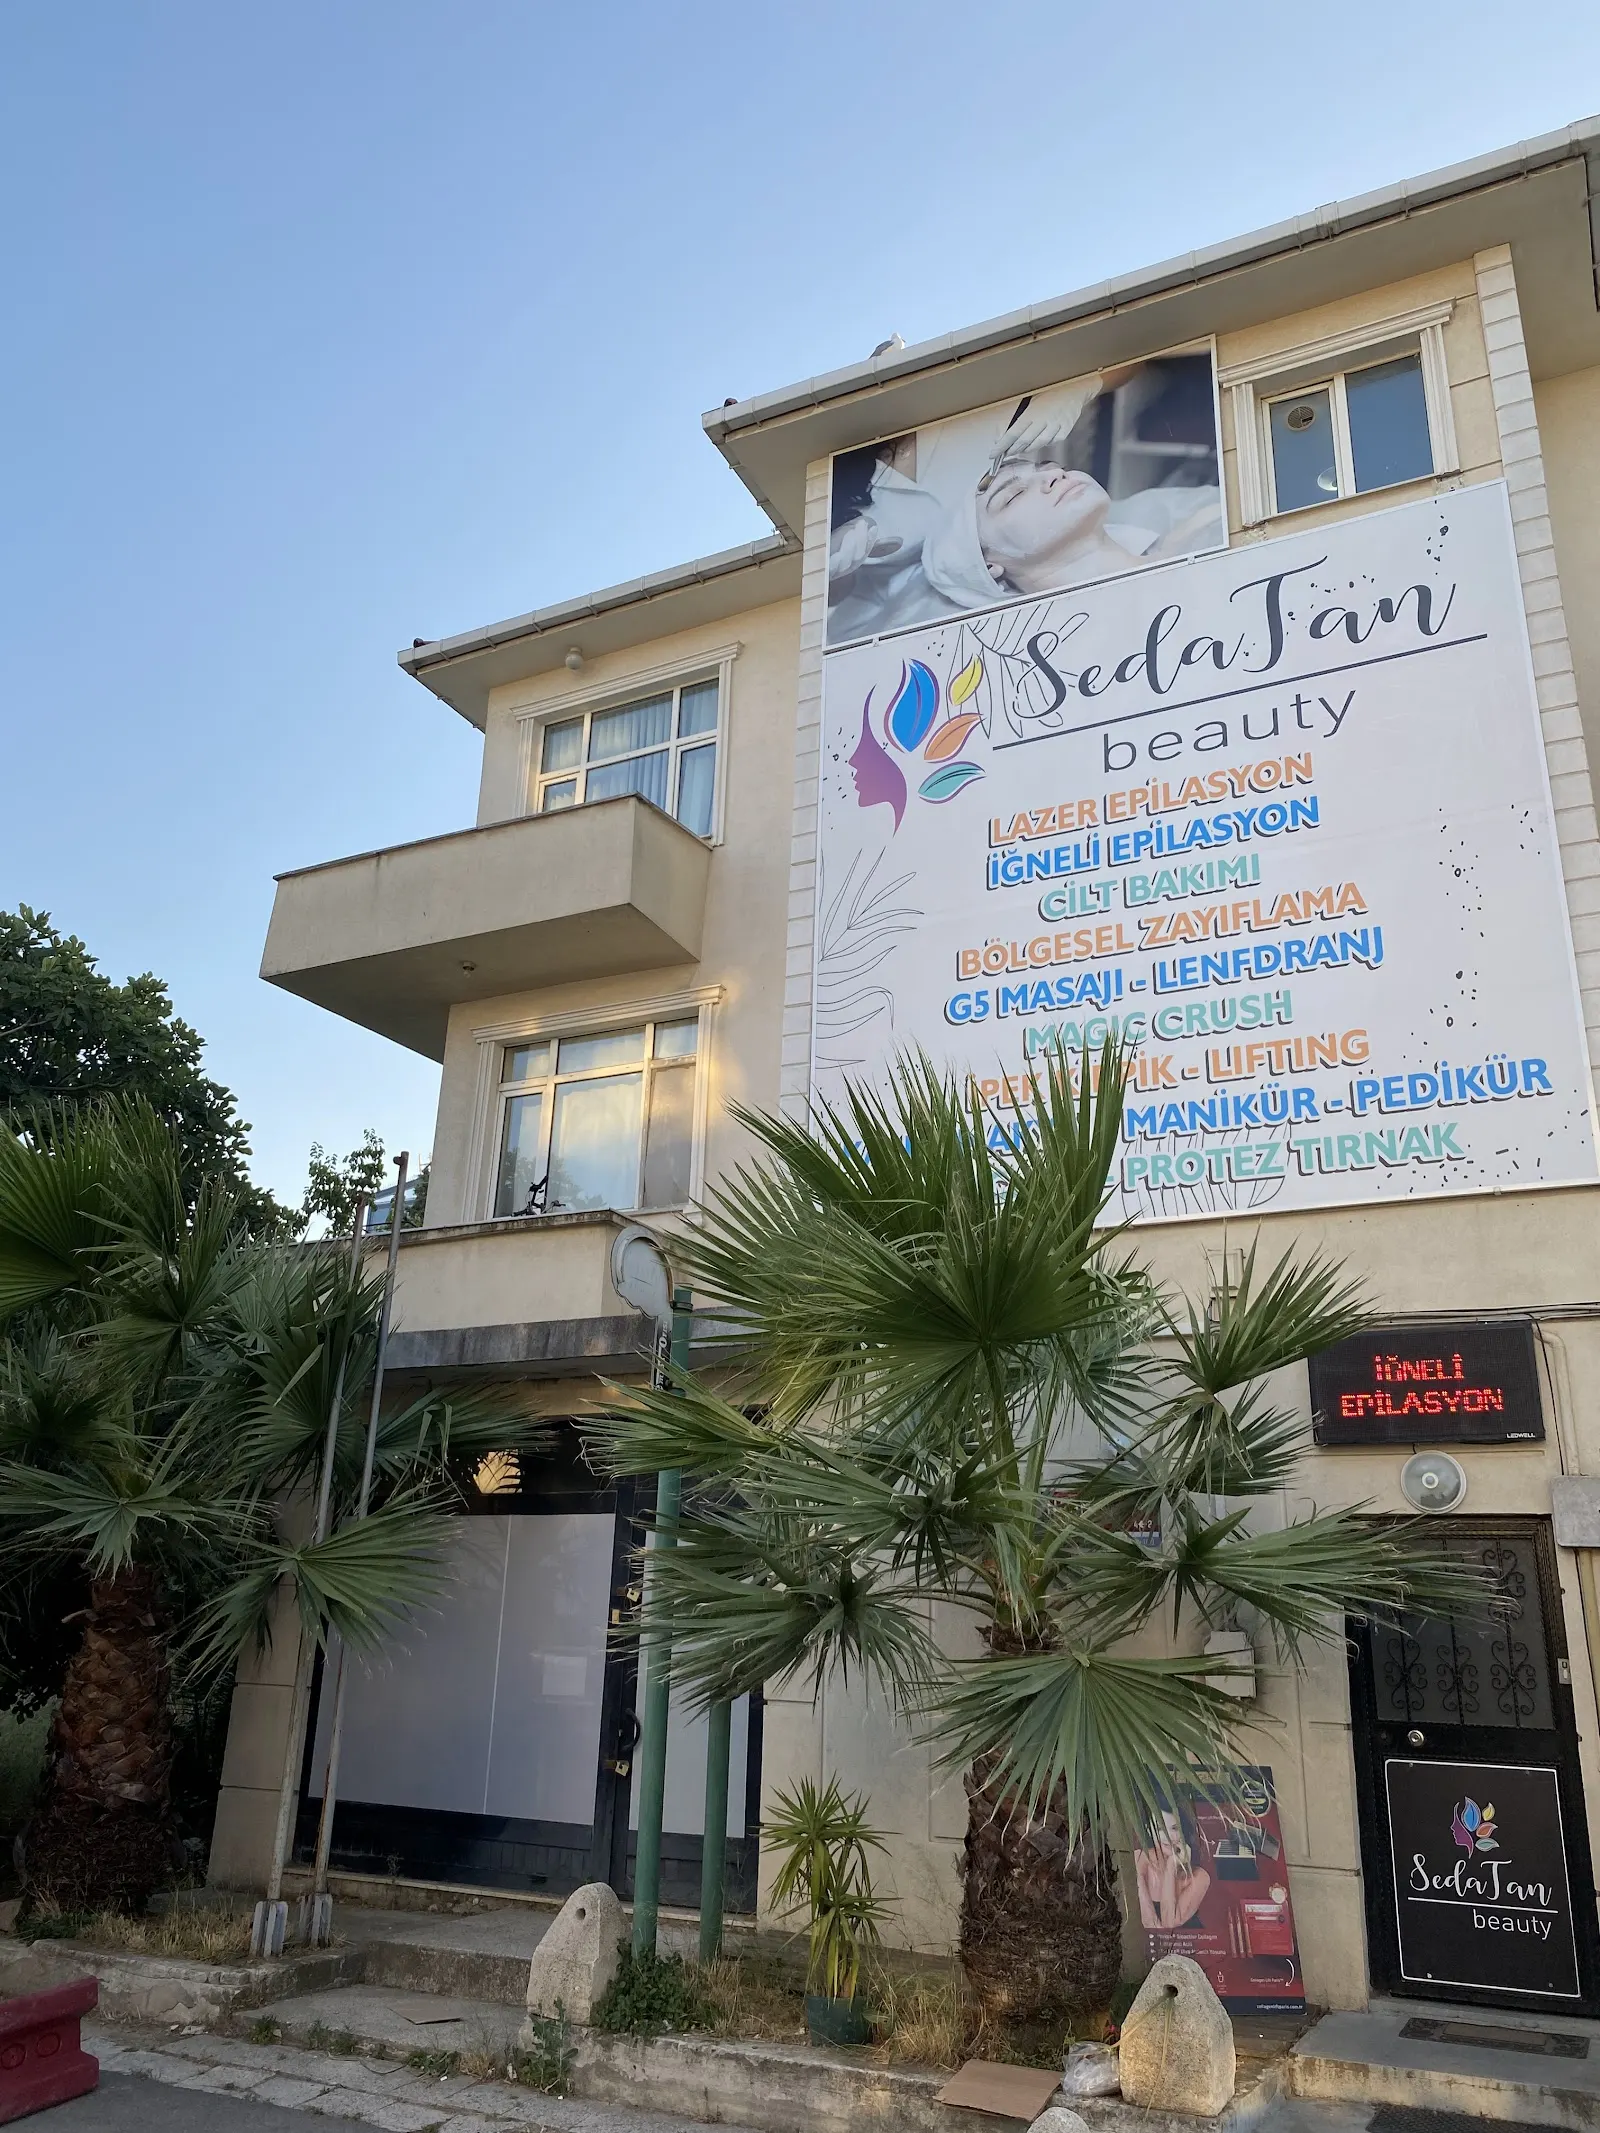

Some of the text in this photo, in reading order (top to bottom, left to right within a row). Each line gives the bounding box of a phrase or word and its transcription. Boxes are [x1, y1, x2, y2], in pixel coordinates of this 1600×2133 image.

[1102, 689, 1356, 772] beauty
[989, 751, 1314, 847] LAZER EPİLASYON
[986, 795, 1320, 889] İĞNELİ EPİLASYON
[1038, 853, 1261, 921] CİLT BAKIMI
[957, 882, 1368, 980] BÖLGESEL ZAYIFLAMA
[945, 990, 991, 1025] G5
[996, 968, 1124, 1016] MASAJI
[1154, 926, 1385, 995] LENFDRANJ
[1023, 990, 1294, 1058] MAGIC CRUSH
[1055, 1050, 1180, 1099] KPİK
[1205, 1029, 1370, 1083] LIFTING
[1122, 1082, 1320, 1141] MANİKÜR
[1350, 1053, 1554, 1117] PEDİKÜR
[1121, 1142, 1285, 1192] PROTEZ
[1287, 1122, 1468, 1174] TIRNAK
[1341, 1388, 1505, 1417] EPİLASYON
[1472, 1908, 1552, 1940] beauty
